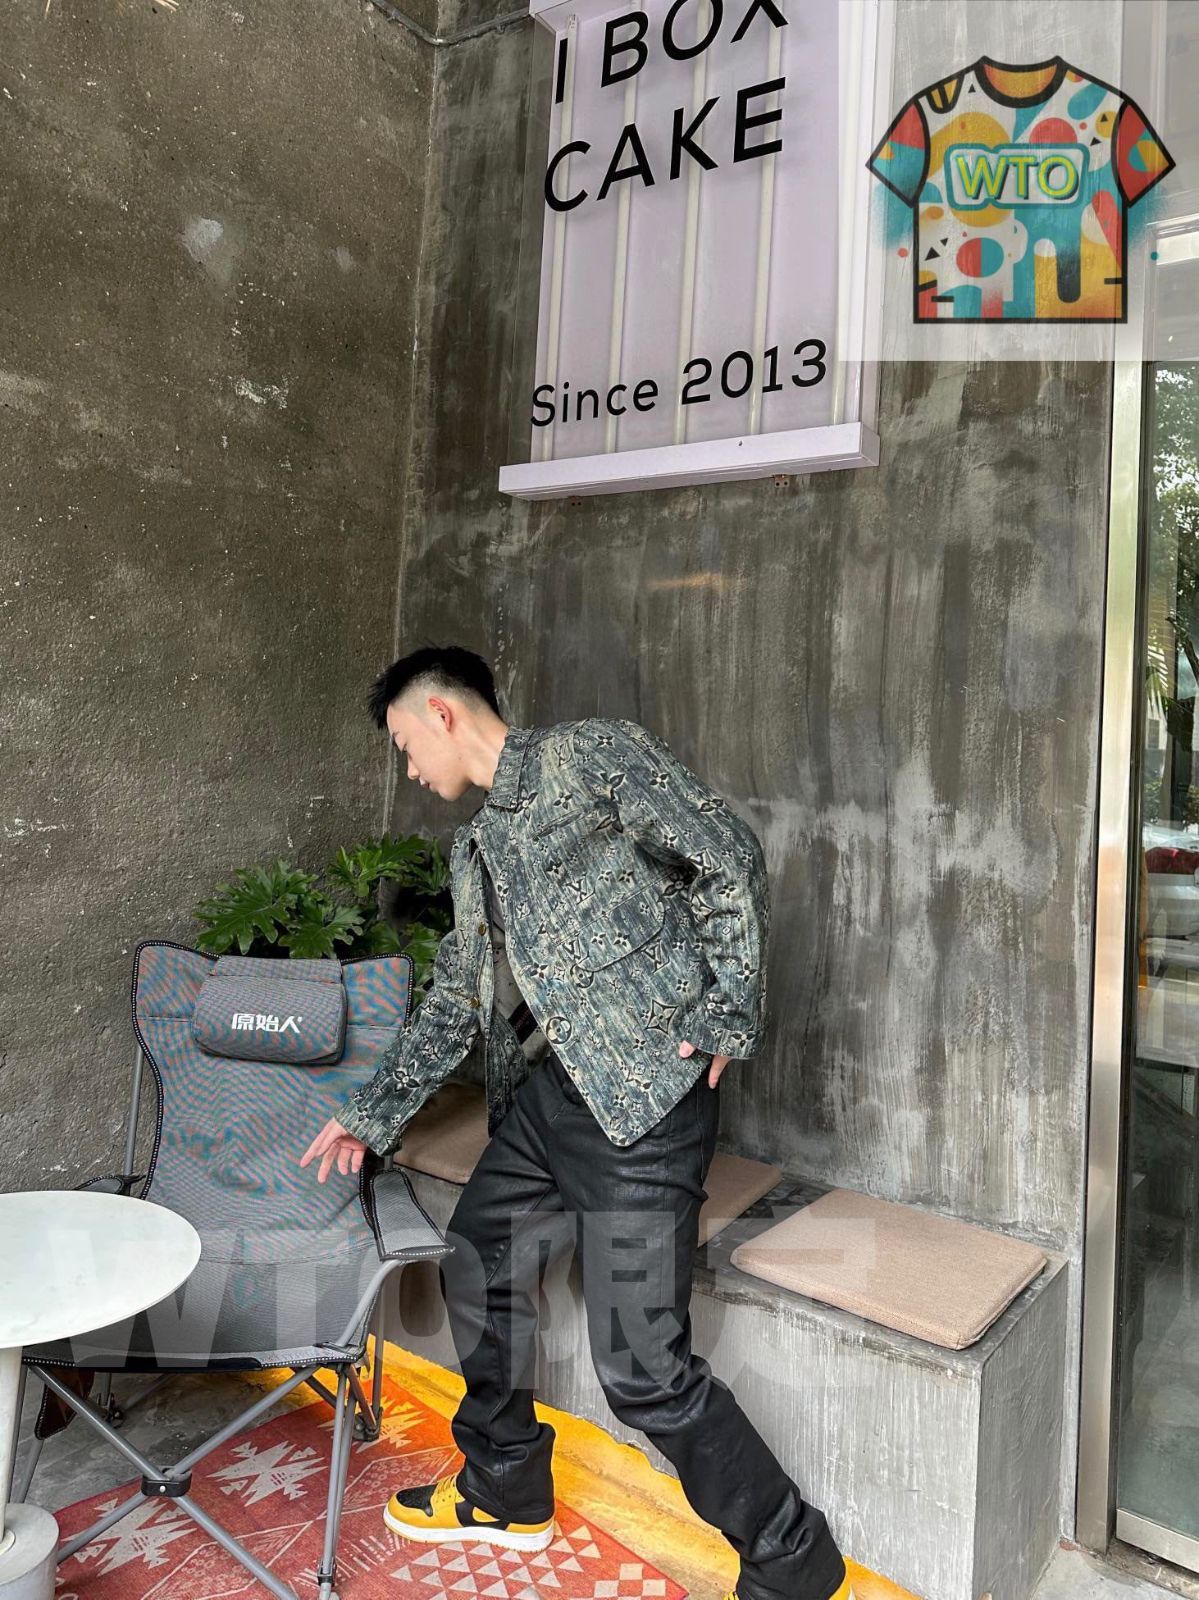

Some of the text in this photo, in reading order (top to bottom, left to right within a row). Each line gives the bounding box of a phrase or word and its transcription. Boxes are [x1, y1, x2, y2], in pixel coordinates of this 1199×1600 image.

[555, 38, 569, 104] I
[544, 77, 786, 212] CAKE
[530, 338, 827, 427] Since 2013
[231, 1013, 300, 1033] 原始人
